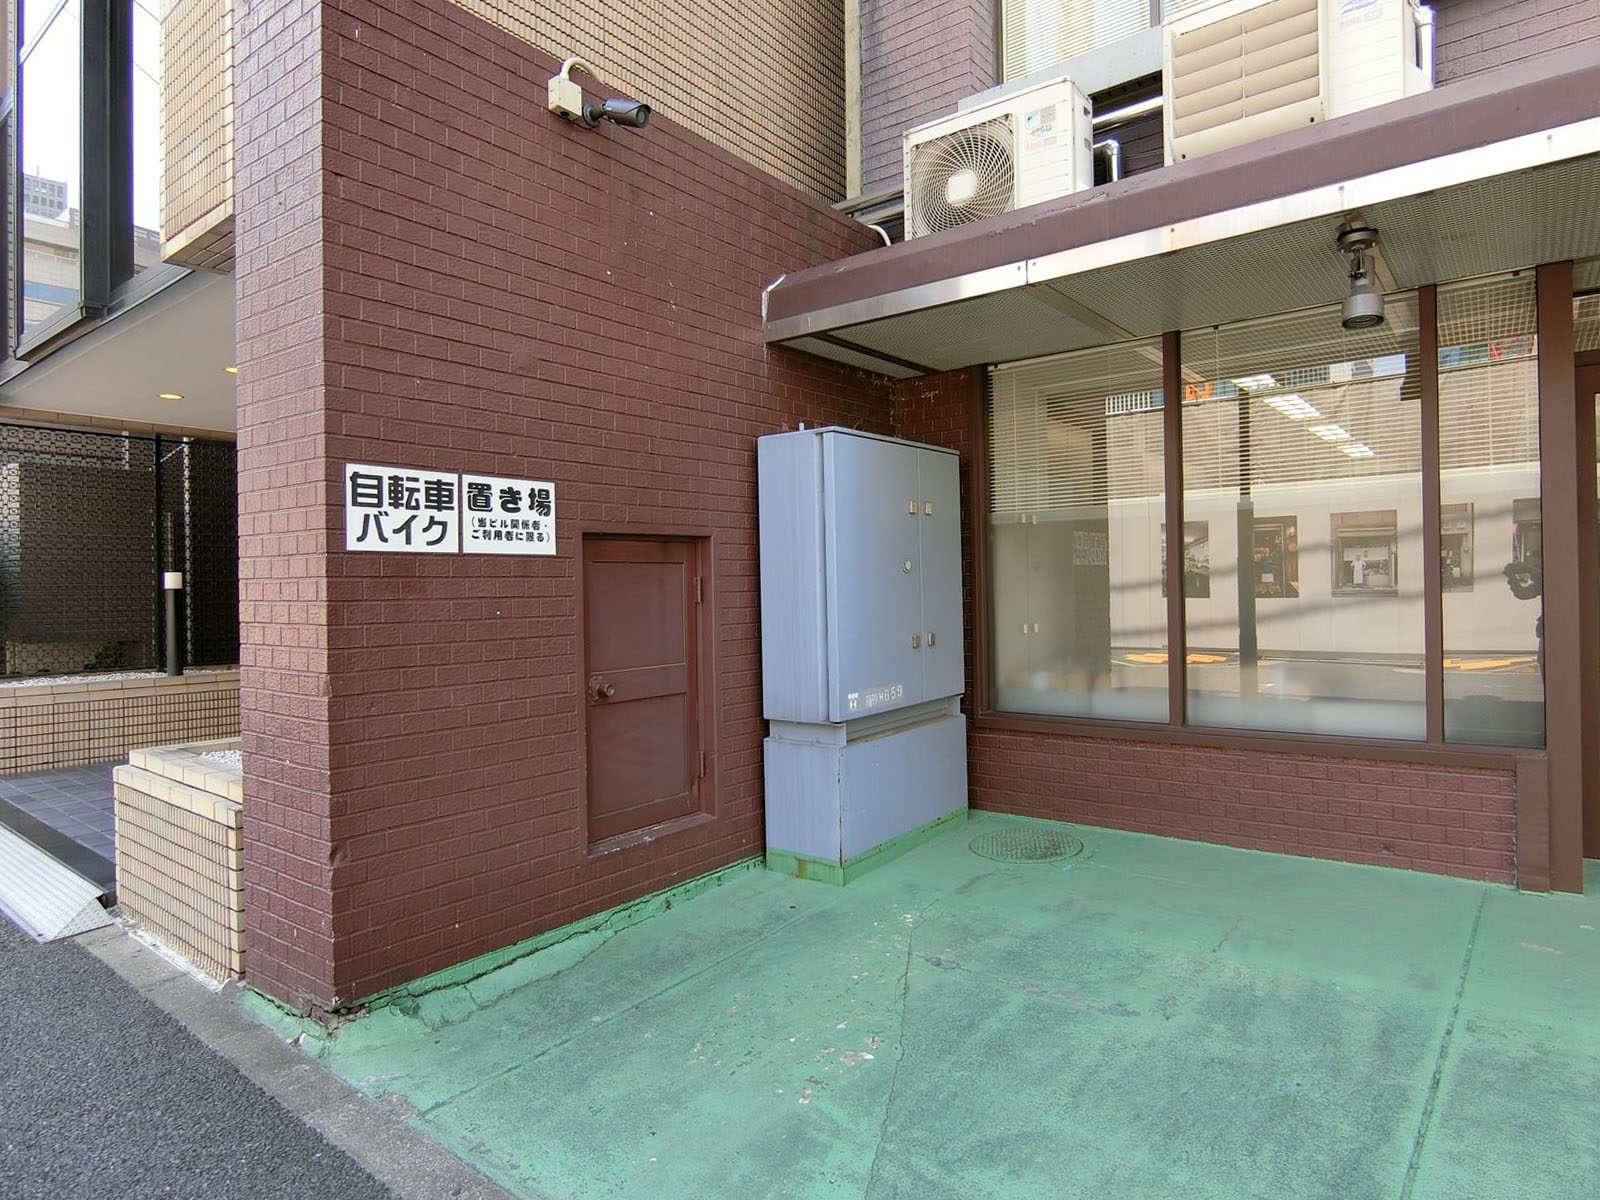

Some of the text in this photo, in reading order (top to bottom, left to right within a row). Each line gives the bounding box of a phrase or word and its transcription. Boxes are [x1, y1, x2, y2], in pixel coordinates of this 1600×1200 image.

[350, 471, 455, 512] 自転車
[467, 482, 552, 517] 置き場
[356, 511, 448, 546] バイク
